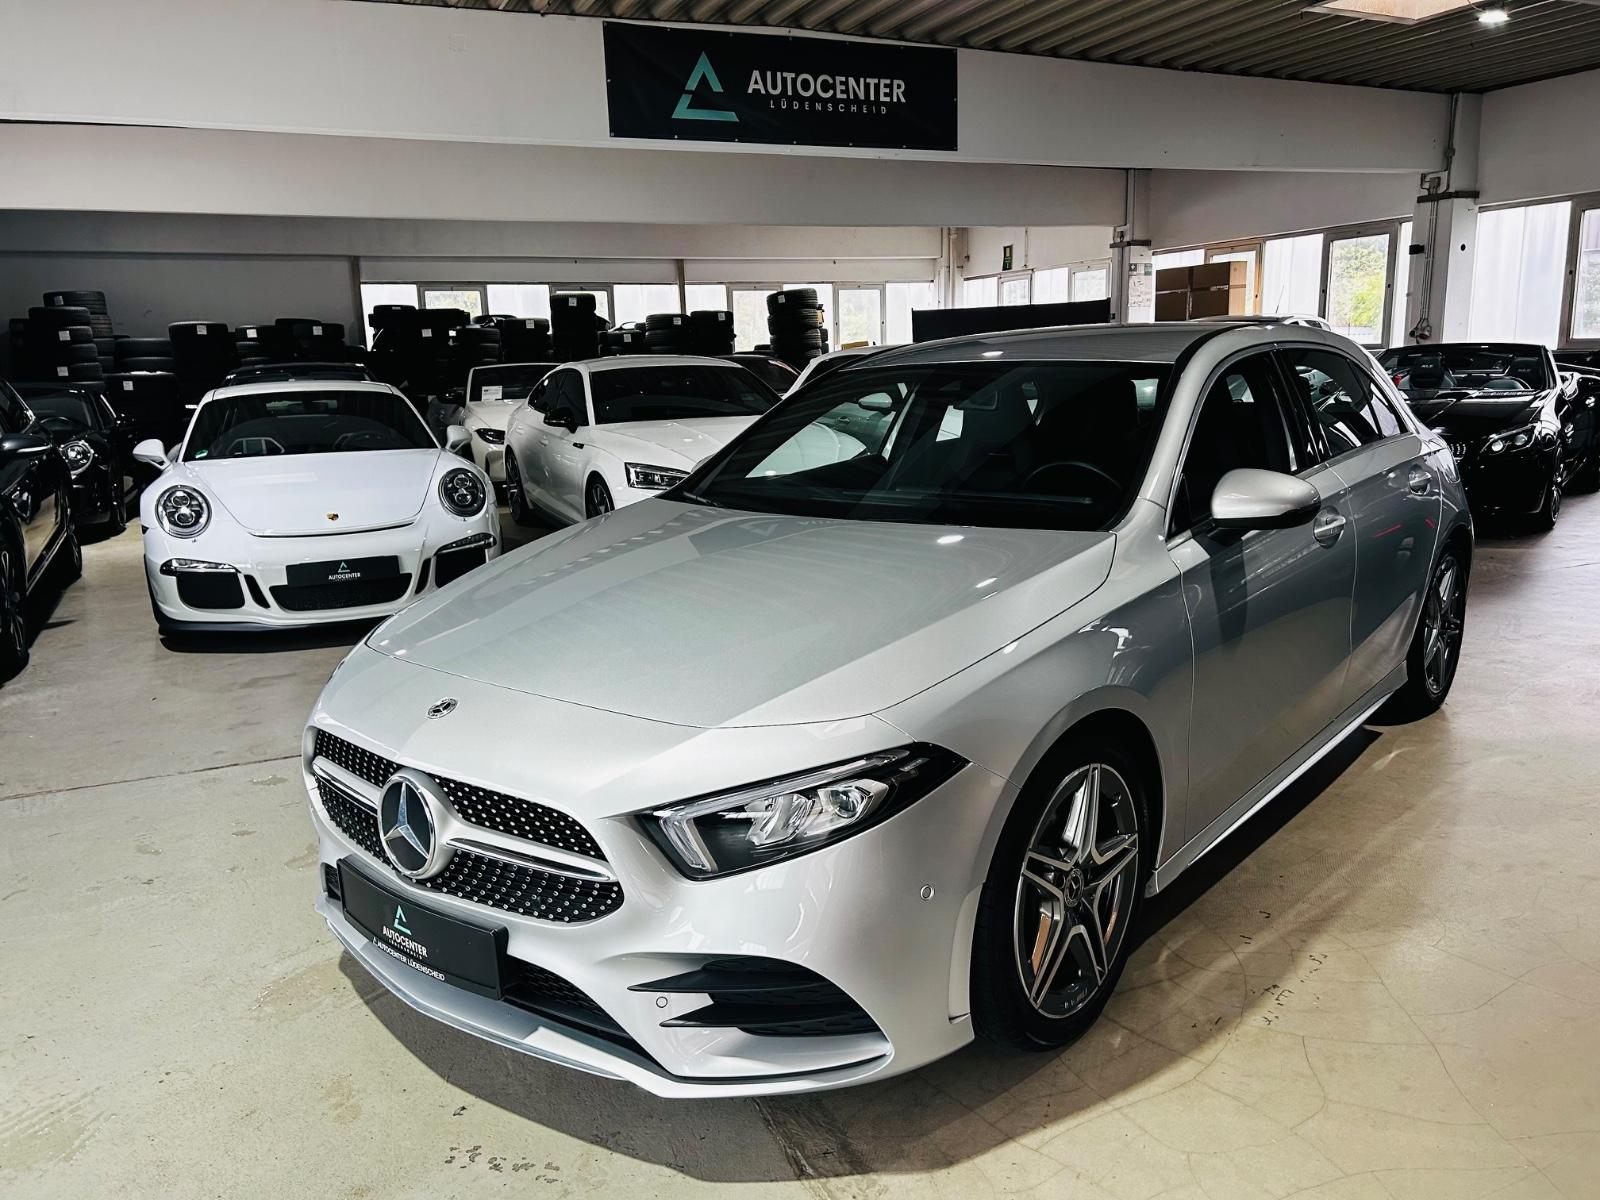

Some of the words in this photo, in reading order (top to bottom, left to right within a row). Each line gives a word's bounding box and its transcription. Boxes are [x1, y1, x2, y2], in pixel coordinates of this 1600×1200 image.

[747, 69, 906, 103] AUTOCENTER
[770, 98, 887, 114] LÜDENSCHEID
[328, 572, 361, 580] AUTOCENTER
[382, 925, 428, 958] AUTOCENTER
[377, 940, 407, 963] AUTOCENTER
[407, 958, 445, 981] LÜDENSCHEID
